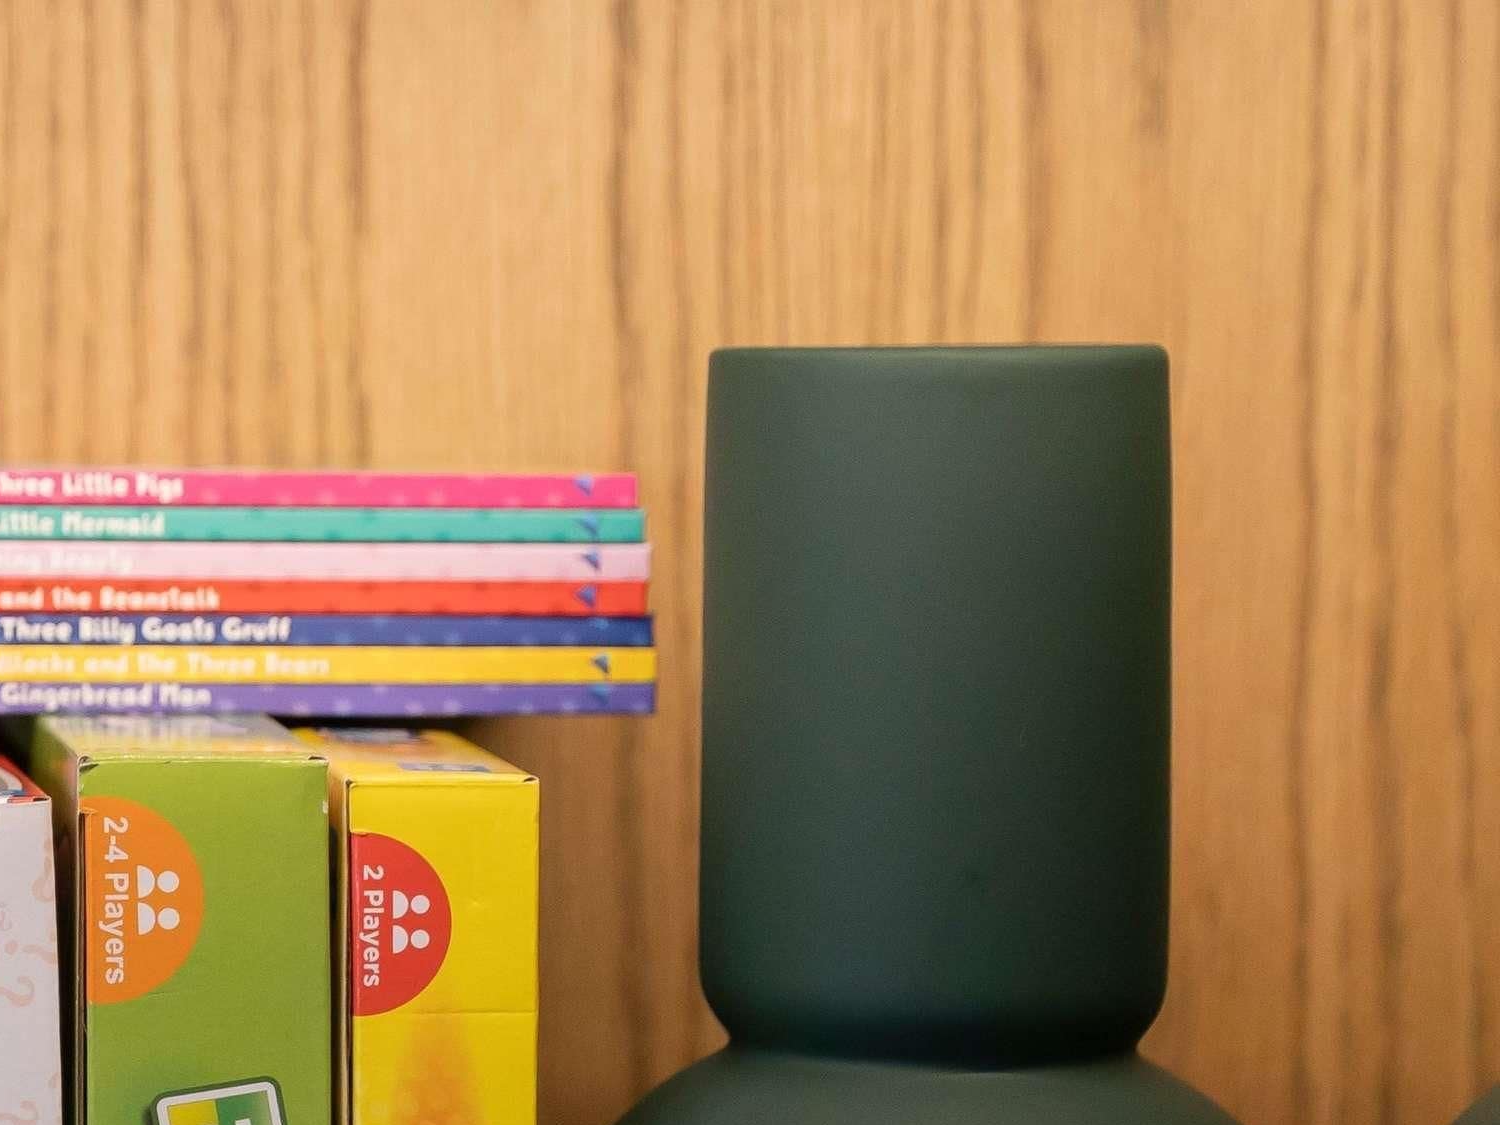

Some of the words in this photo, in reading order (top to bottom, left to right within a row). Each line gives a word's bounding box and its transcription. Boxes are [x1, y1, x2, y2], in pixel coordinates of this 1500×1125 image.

[61, 471, 130, 498] Little
[136, 473, 184, 502] Pigs
[60, 512, 166, 537] Mermaid
[99, 586, 221, 611] Beanstalk
[0, 616, 73, 643] Three
[78, 616, 137, 644] Billy
[141, 616, 216, 643] Goats
[221, 616, 292, 643] Gruff
[83, 652, 129, 676] and
[187, 652, 257, 676] Three
[265, 652, 330, 677] Bears
[0, 683, 153, 711] Gingerbread
[159, 684, 212, 707] Man
[100, 815, 130, 864] 2-4
[362, 865, 384, 881] 2
[97, 871, 130, 987] Players
[361, 889, 384, 988] Players
